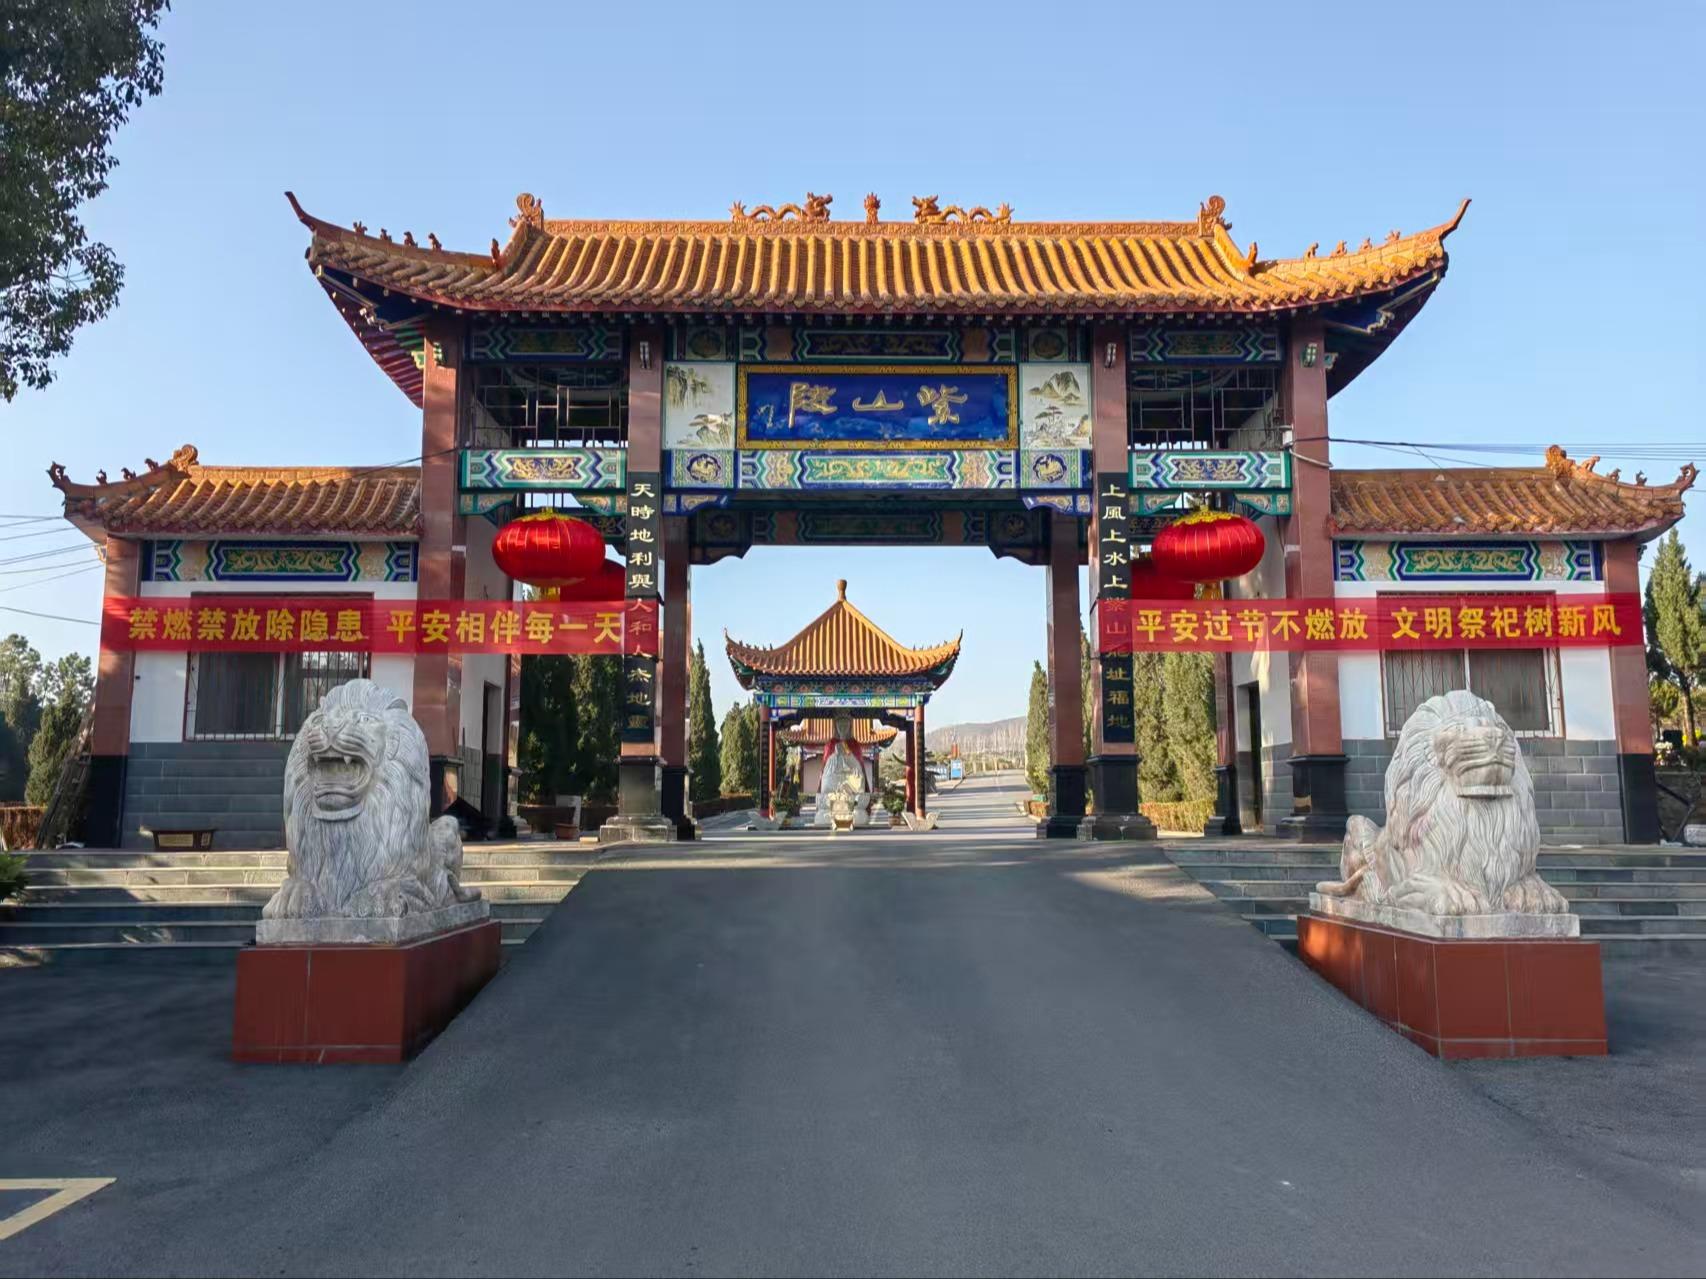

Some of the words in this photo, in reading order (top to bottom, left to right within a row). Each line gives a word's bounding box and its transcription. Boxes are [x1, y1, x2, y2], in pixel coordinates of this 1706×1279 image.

[128, 607, 364, 642] 禁燃禁放除隐患
[387, 609, 622, 644] 平安相伴每一天
[1136, 607, 1370, 642] 平安过节不燃放
[1390, 604, 1622, 640] 文明祭祀树新风
